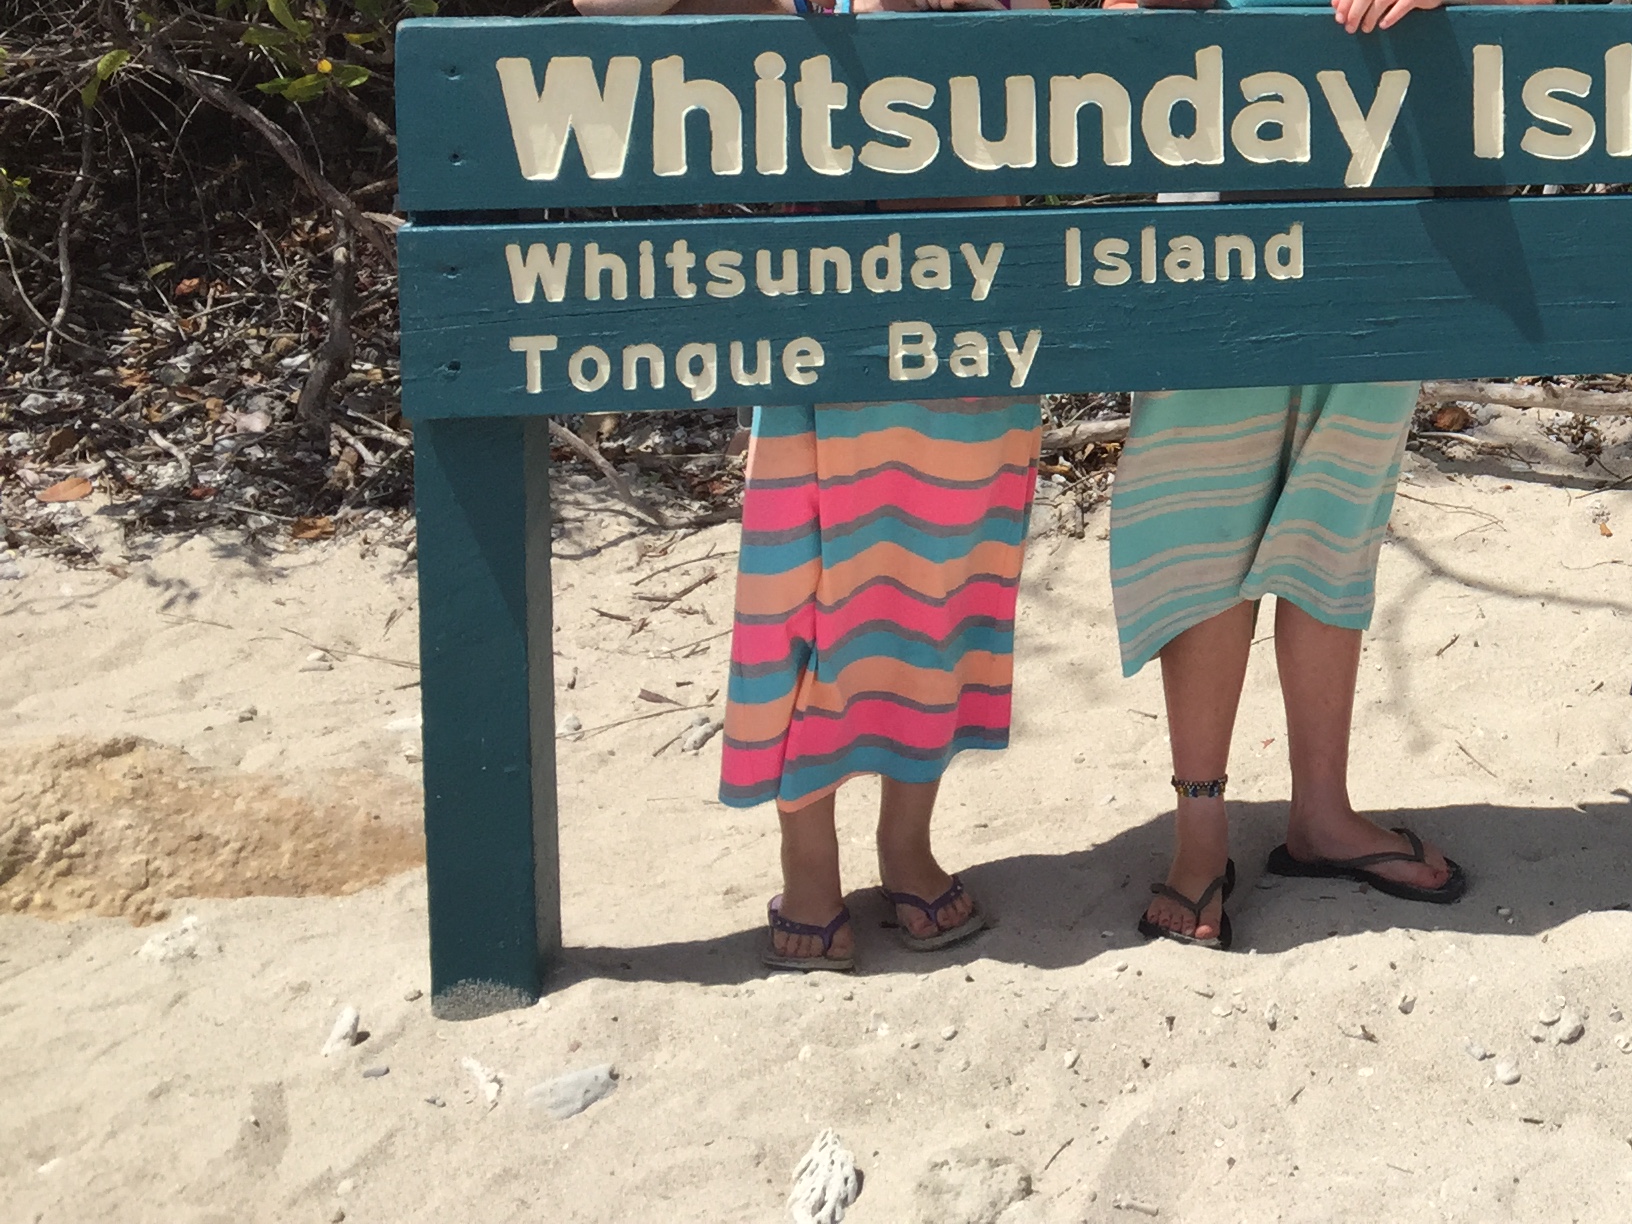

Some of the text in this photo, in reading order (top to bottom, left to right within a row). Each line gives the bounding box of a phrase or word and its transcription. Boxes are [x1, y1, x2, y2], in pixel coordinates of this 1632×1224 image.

[494, 43, 1412, 190] Whitsunday
[505, 223, 1306, 305] Whitsunday Island
[508, 319, 1044, 403] Tongue Bay
